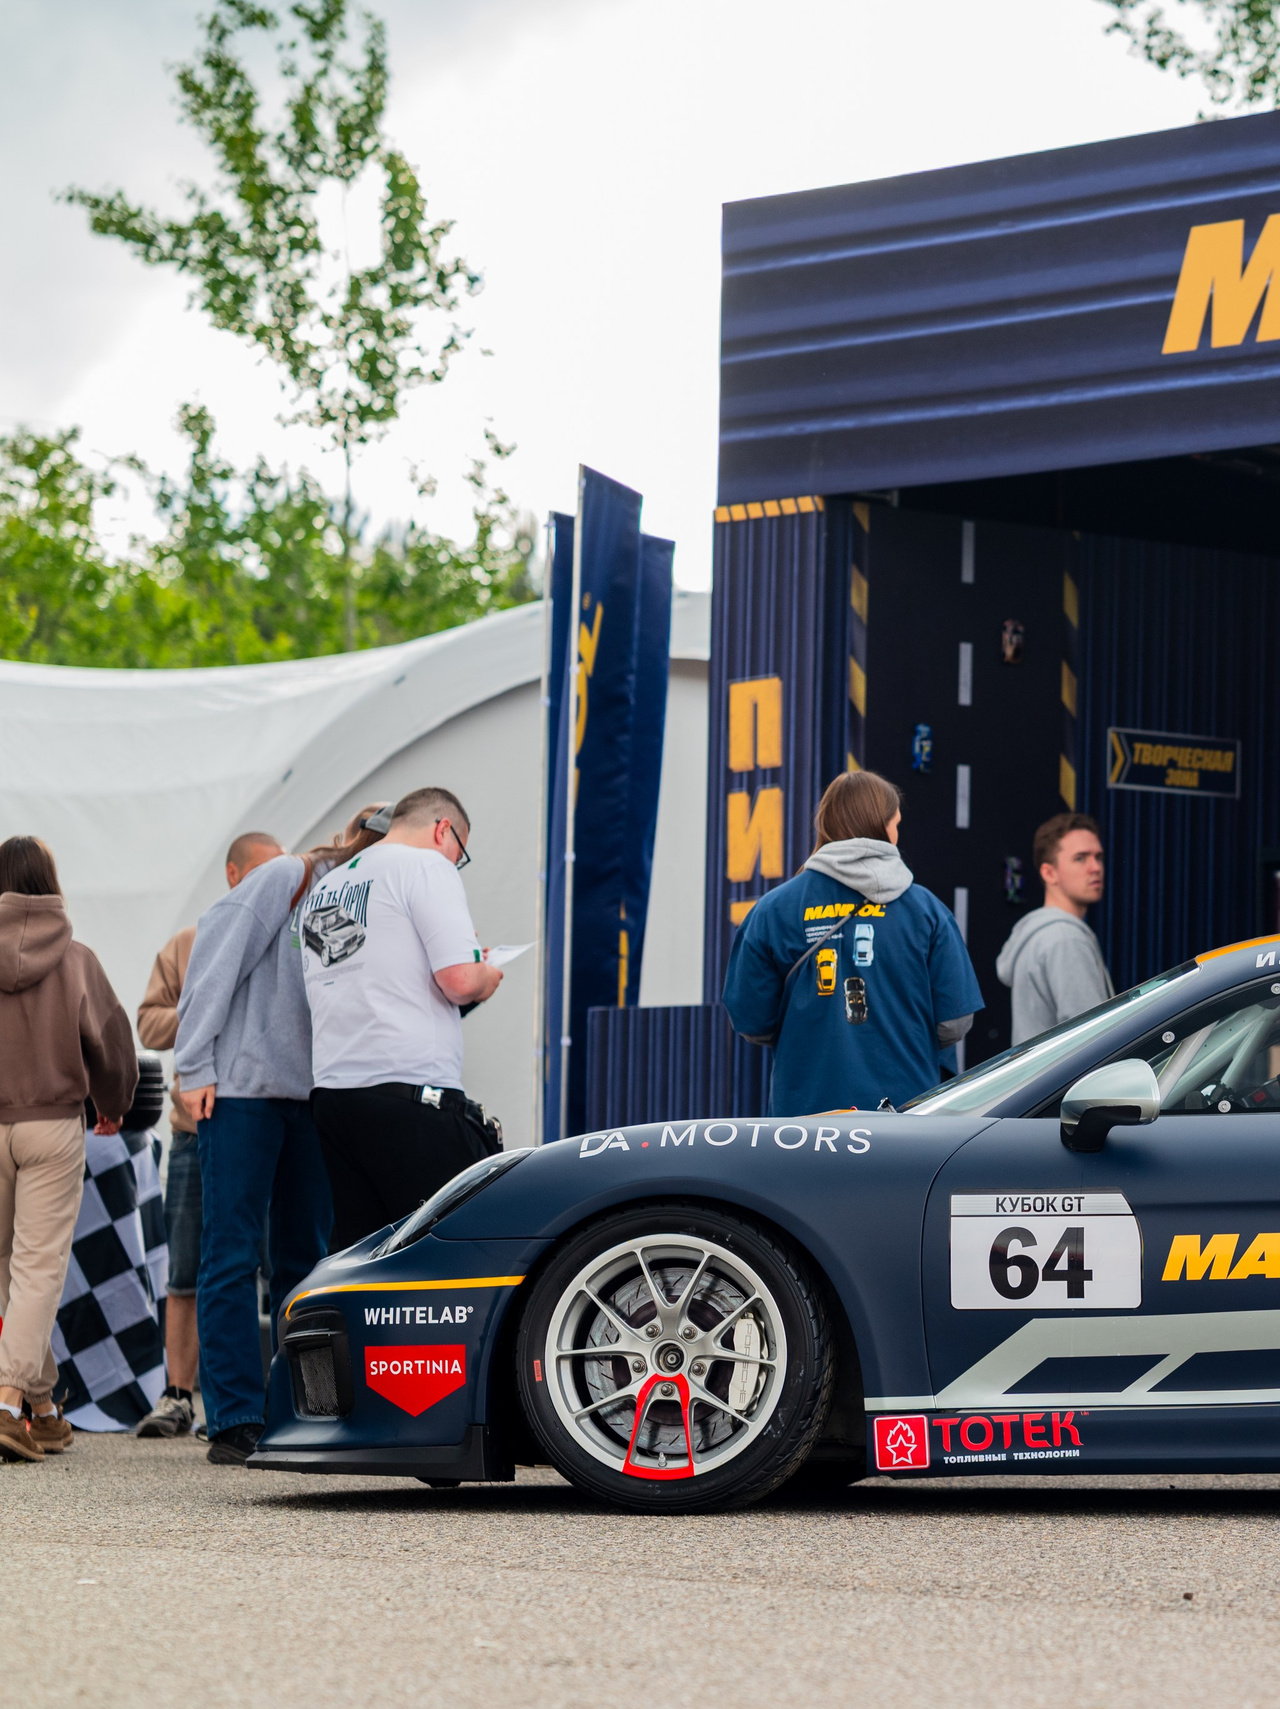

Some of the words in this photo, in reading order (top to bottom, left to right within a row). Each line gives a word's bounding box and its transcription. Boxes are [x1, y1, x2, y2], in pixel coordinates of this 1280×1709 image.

[726, 677, 783, 927] ПИ
[660, 1123, 872, 1154] MOTORS
[995, 1196, 1058, 1213] КУБОК
[1061, 1196, 1085, 1213] GT
[988, 1226, 1093, 1300] 64
[370, 1360, 462, 1375] SPORTINIA
[943, 1453, 1007, 1465] ТОПЛИВНЫЕ
[1013, 1449, 1080, 1461] ТЕХНОЛОГИИ
